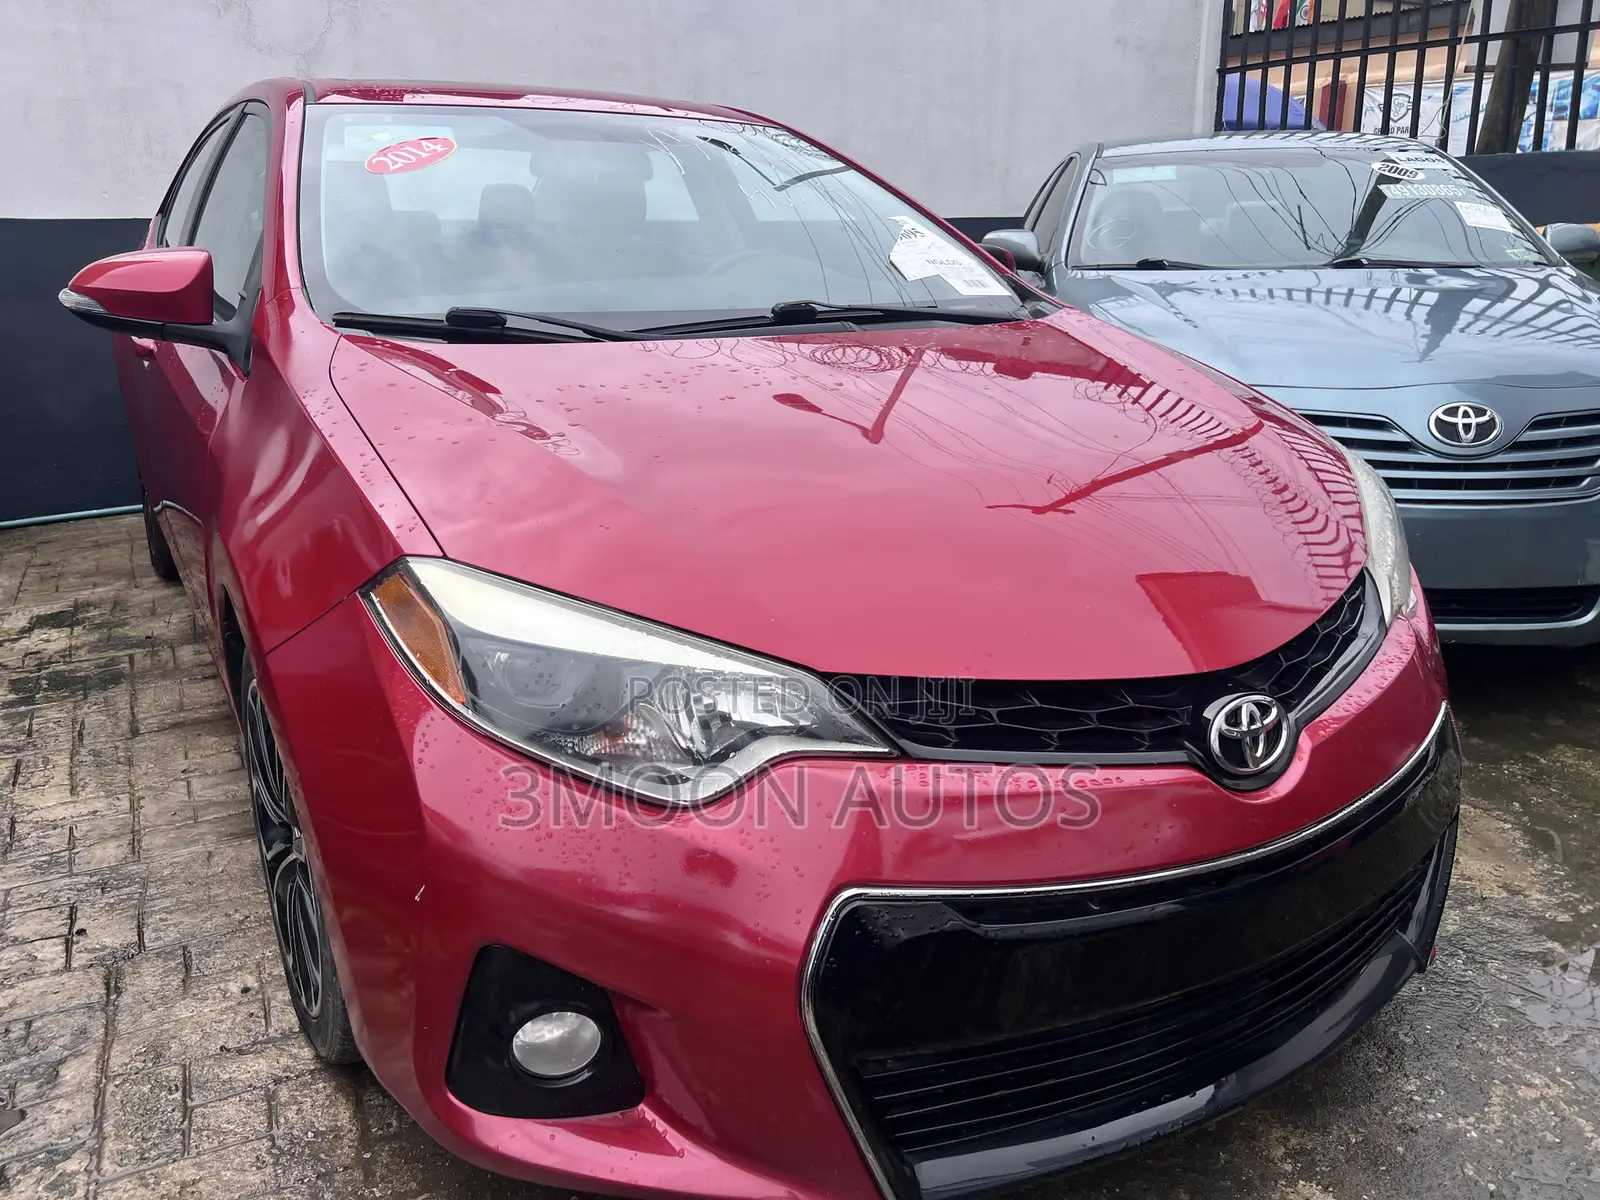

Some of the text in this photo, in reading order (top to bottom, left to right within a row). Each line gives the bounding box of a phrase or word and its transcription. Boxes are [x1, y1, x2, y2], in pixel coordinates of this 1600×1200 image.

[1373, 127, 1394, 135] GRD
[372, 141, 448, 171] 2014
[1377, 163, 1420, 179] 2009
